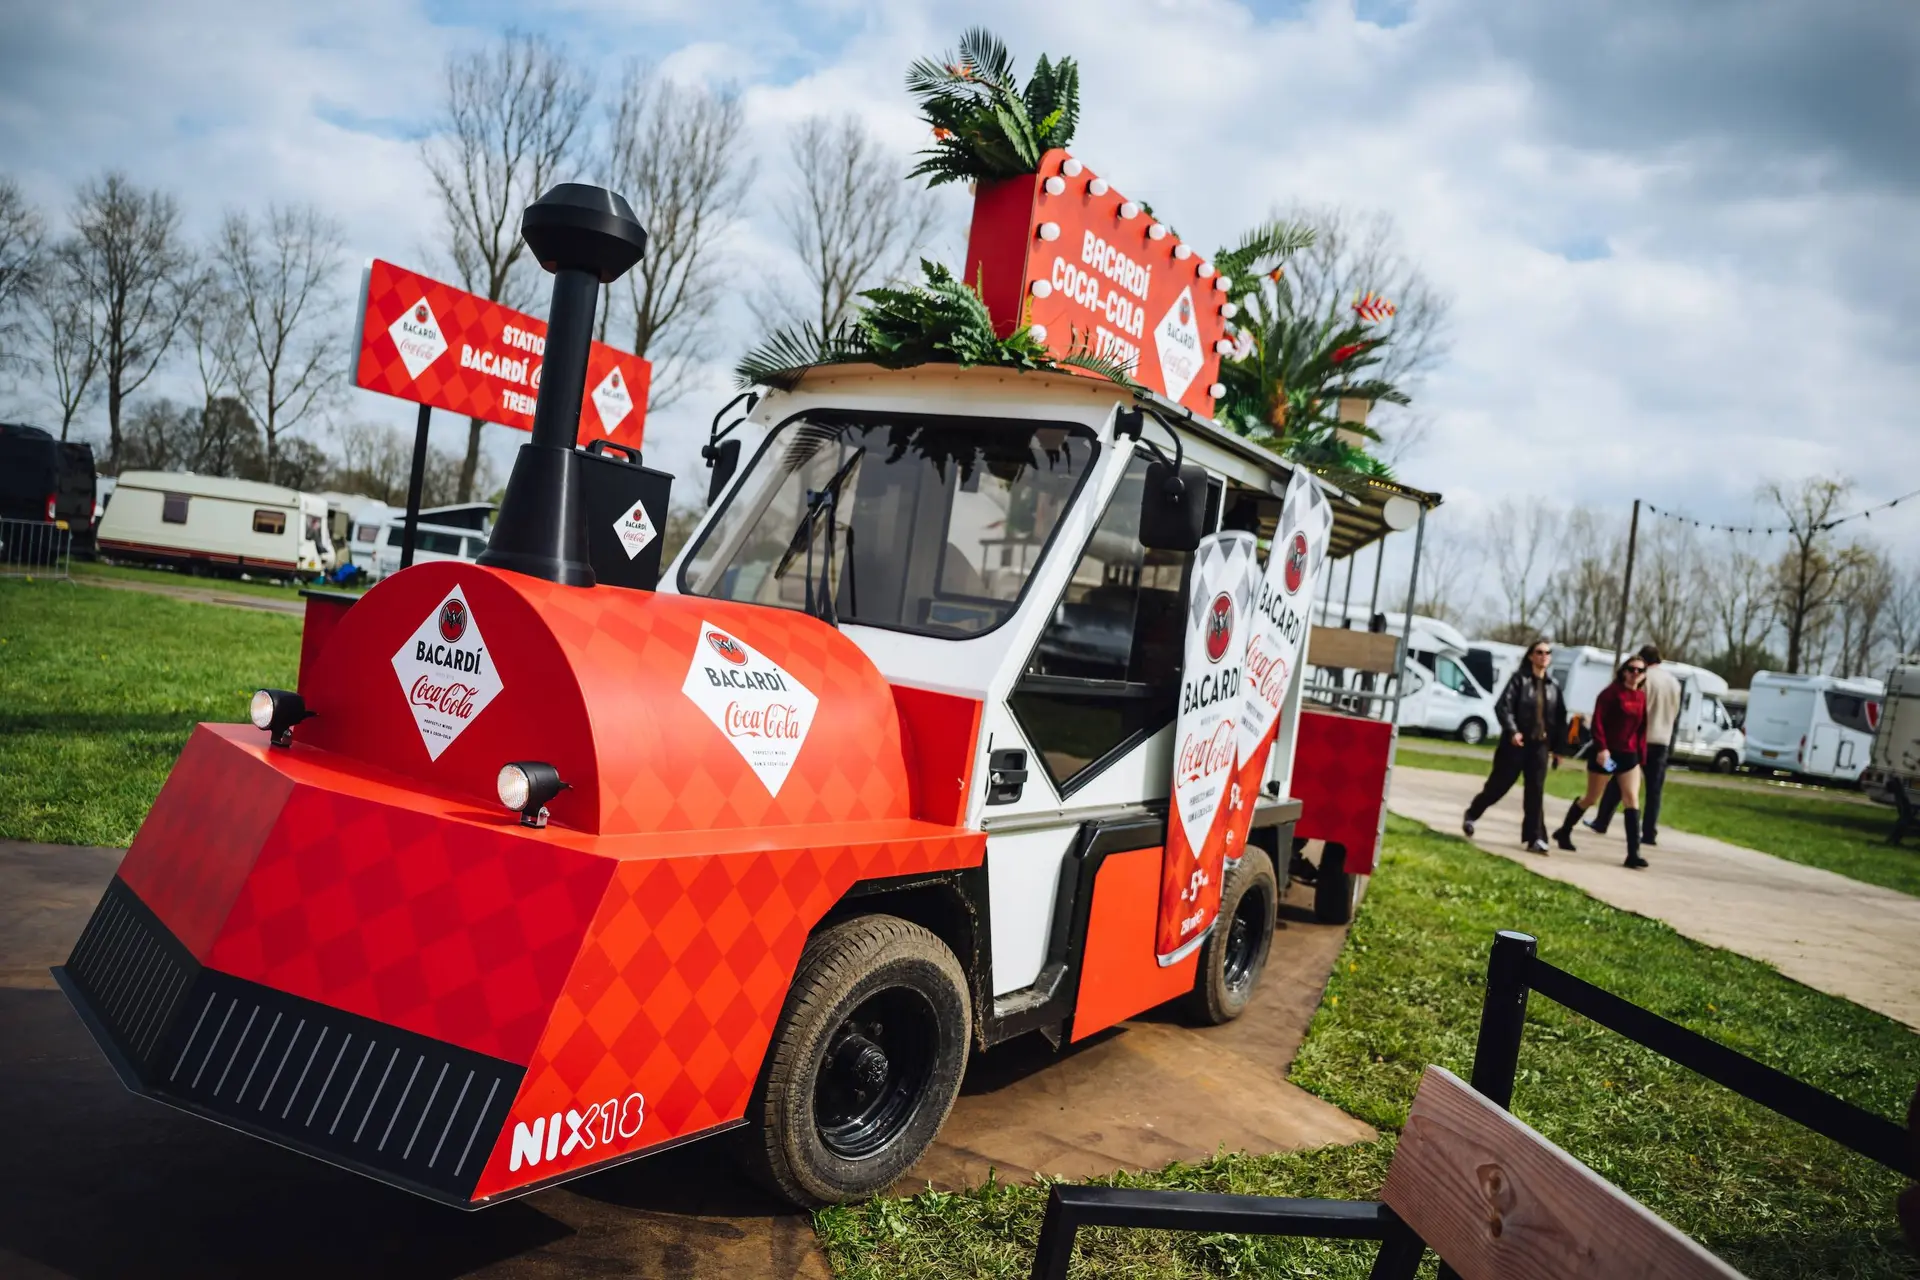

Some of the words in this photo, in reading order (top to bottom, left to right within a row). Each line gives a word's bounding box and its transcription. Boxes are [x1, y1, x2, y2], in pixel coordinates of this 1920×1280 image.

[1081, 229, 1152, 301] BACARDÍ
[1052, 256, 1145, 339] COCA-COLA
[502, 324, 546, 356] STATIO
[460, 344, 530, 385] BACARDÍ
[415, 640, 483, 675] BACARDÍ
[410, 674, 480, 719] Coca-Cola
[704, 667, 788, 692] BACARDÍ
[724, 700, 800, 739] Coca-Cola
[509, 1092, 645, 1172] NIX18
